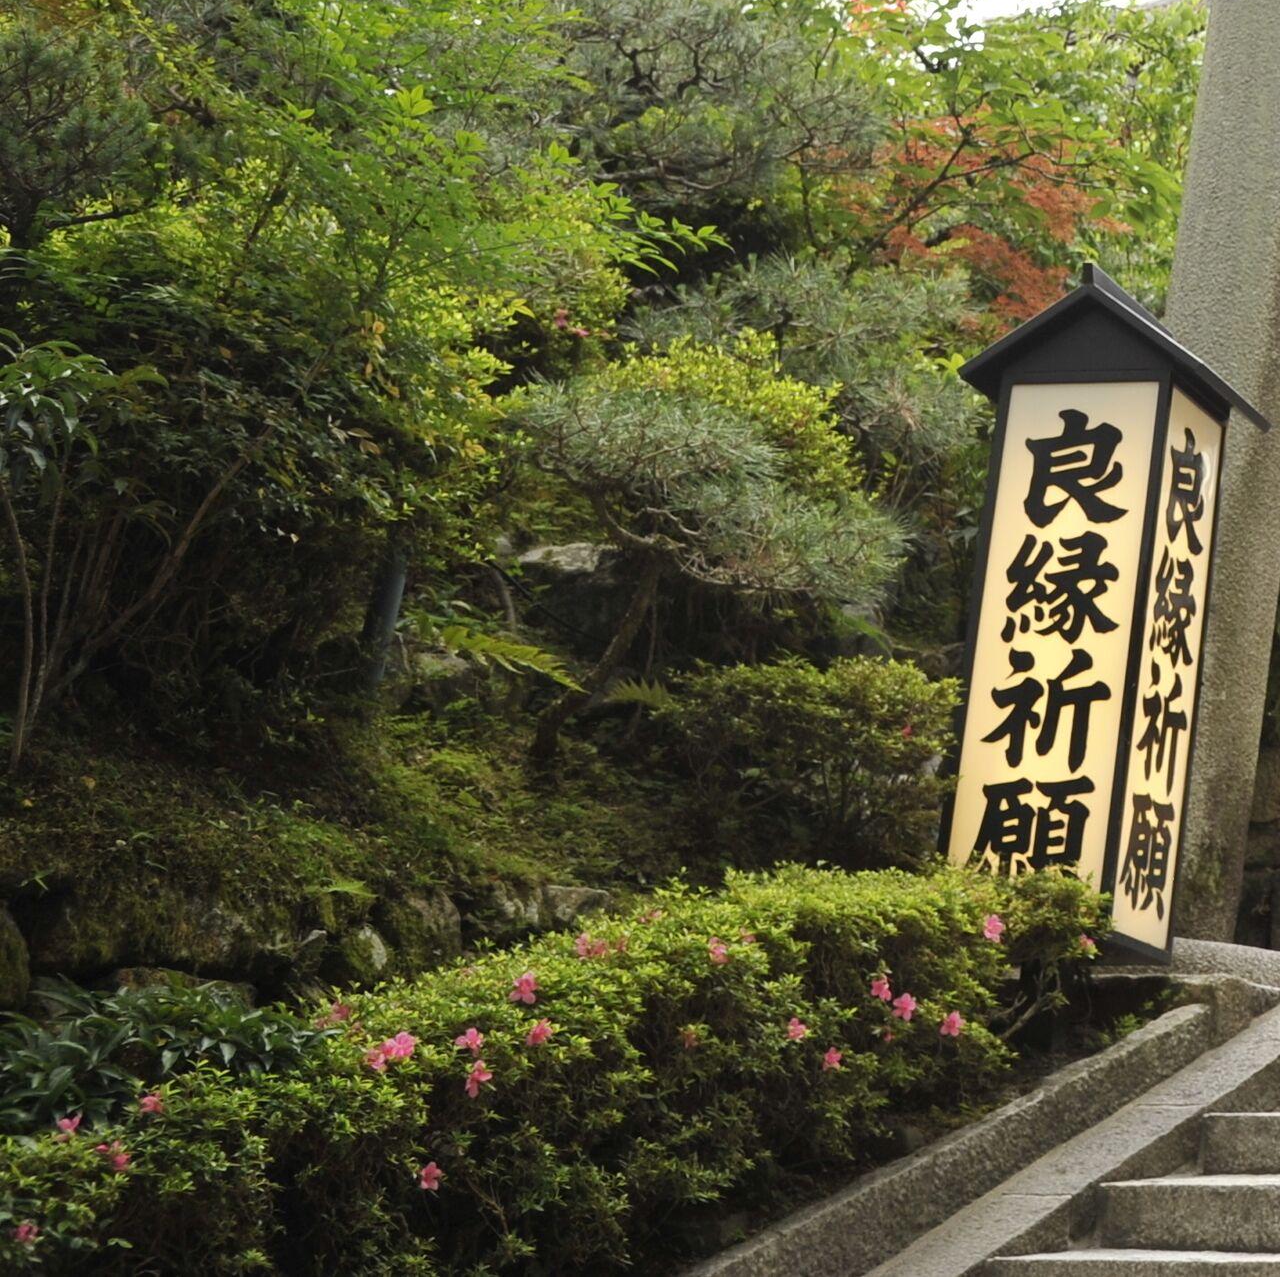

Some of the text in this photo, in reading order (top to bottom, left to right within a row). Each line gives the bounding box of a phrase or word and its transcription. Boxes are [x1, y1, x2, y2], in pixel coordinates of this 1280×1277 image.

[965, 409, 1129, 880] 良縁祈願
[1119, 428, 1205, 921] 良縁祈願
